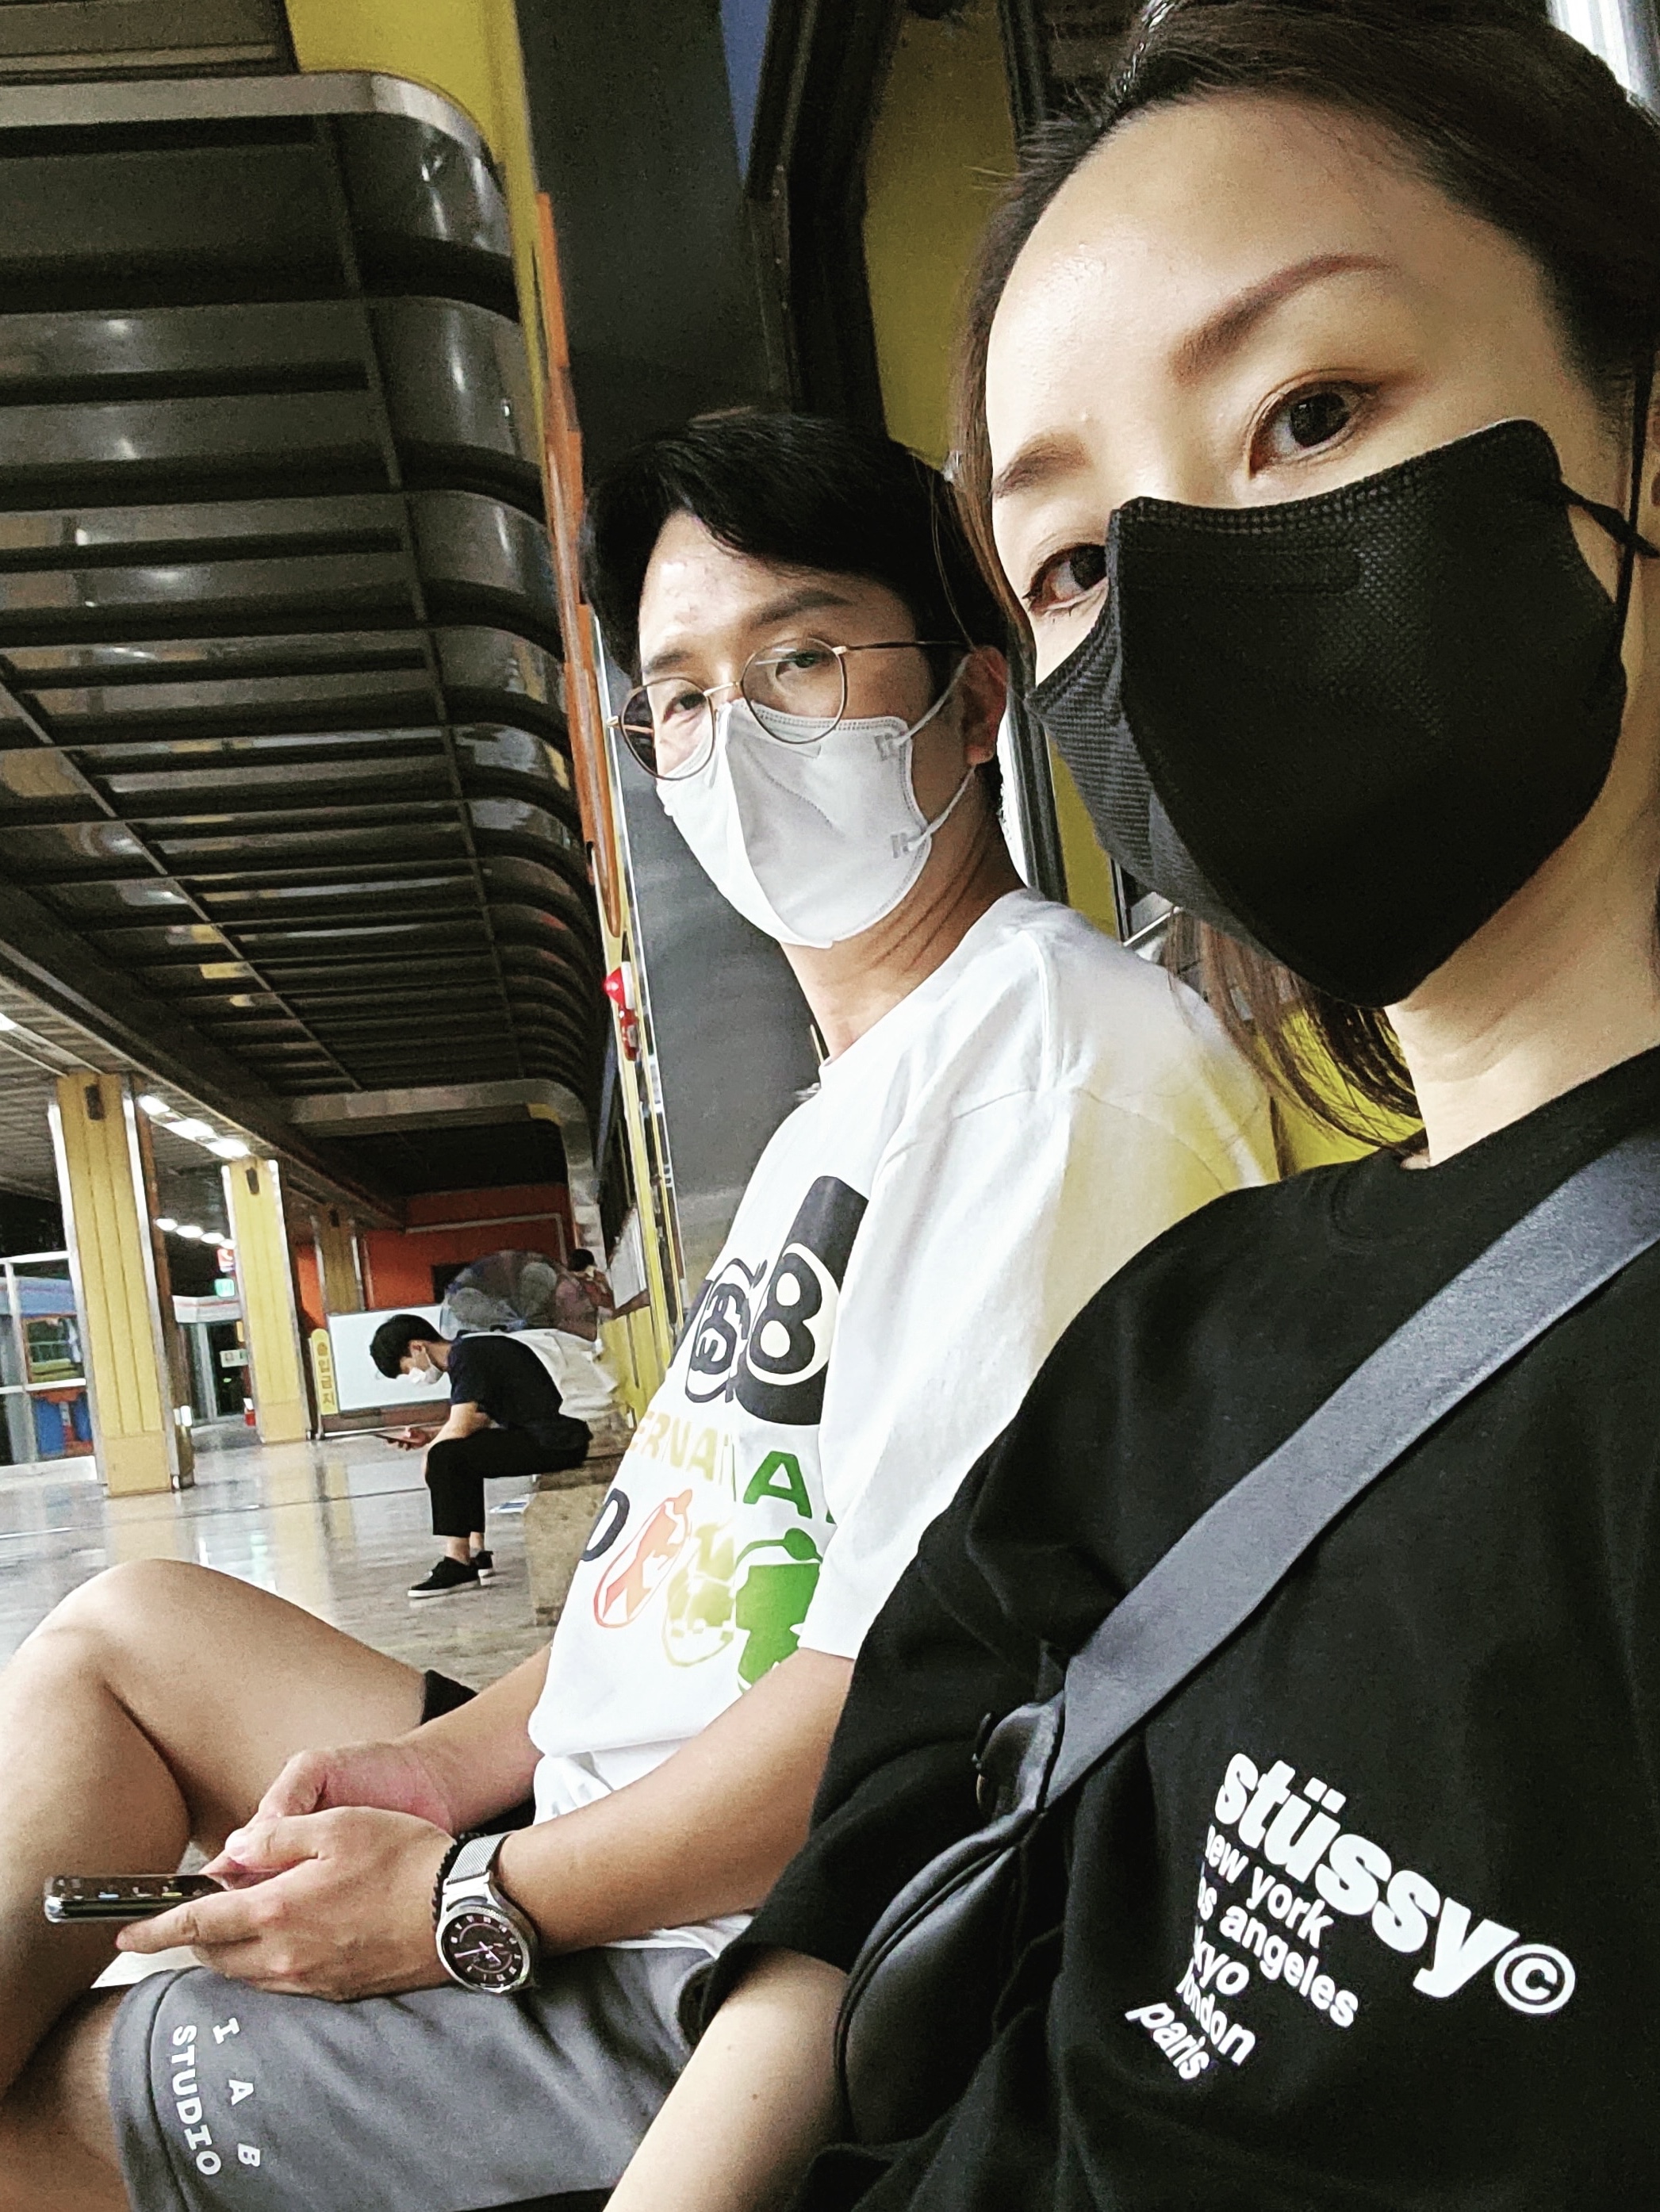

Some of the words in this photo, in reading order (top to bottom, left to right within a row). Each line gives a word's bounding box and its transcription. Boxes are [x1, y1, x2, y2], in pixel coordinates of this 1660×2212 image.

[1246, 1866, 1335, 1949] york
[1219, 1905, 1359, 2029] angeles
[1125, 2002, 1210, 2080] paris
[171, 2025, 222, 2176] STUDIO
